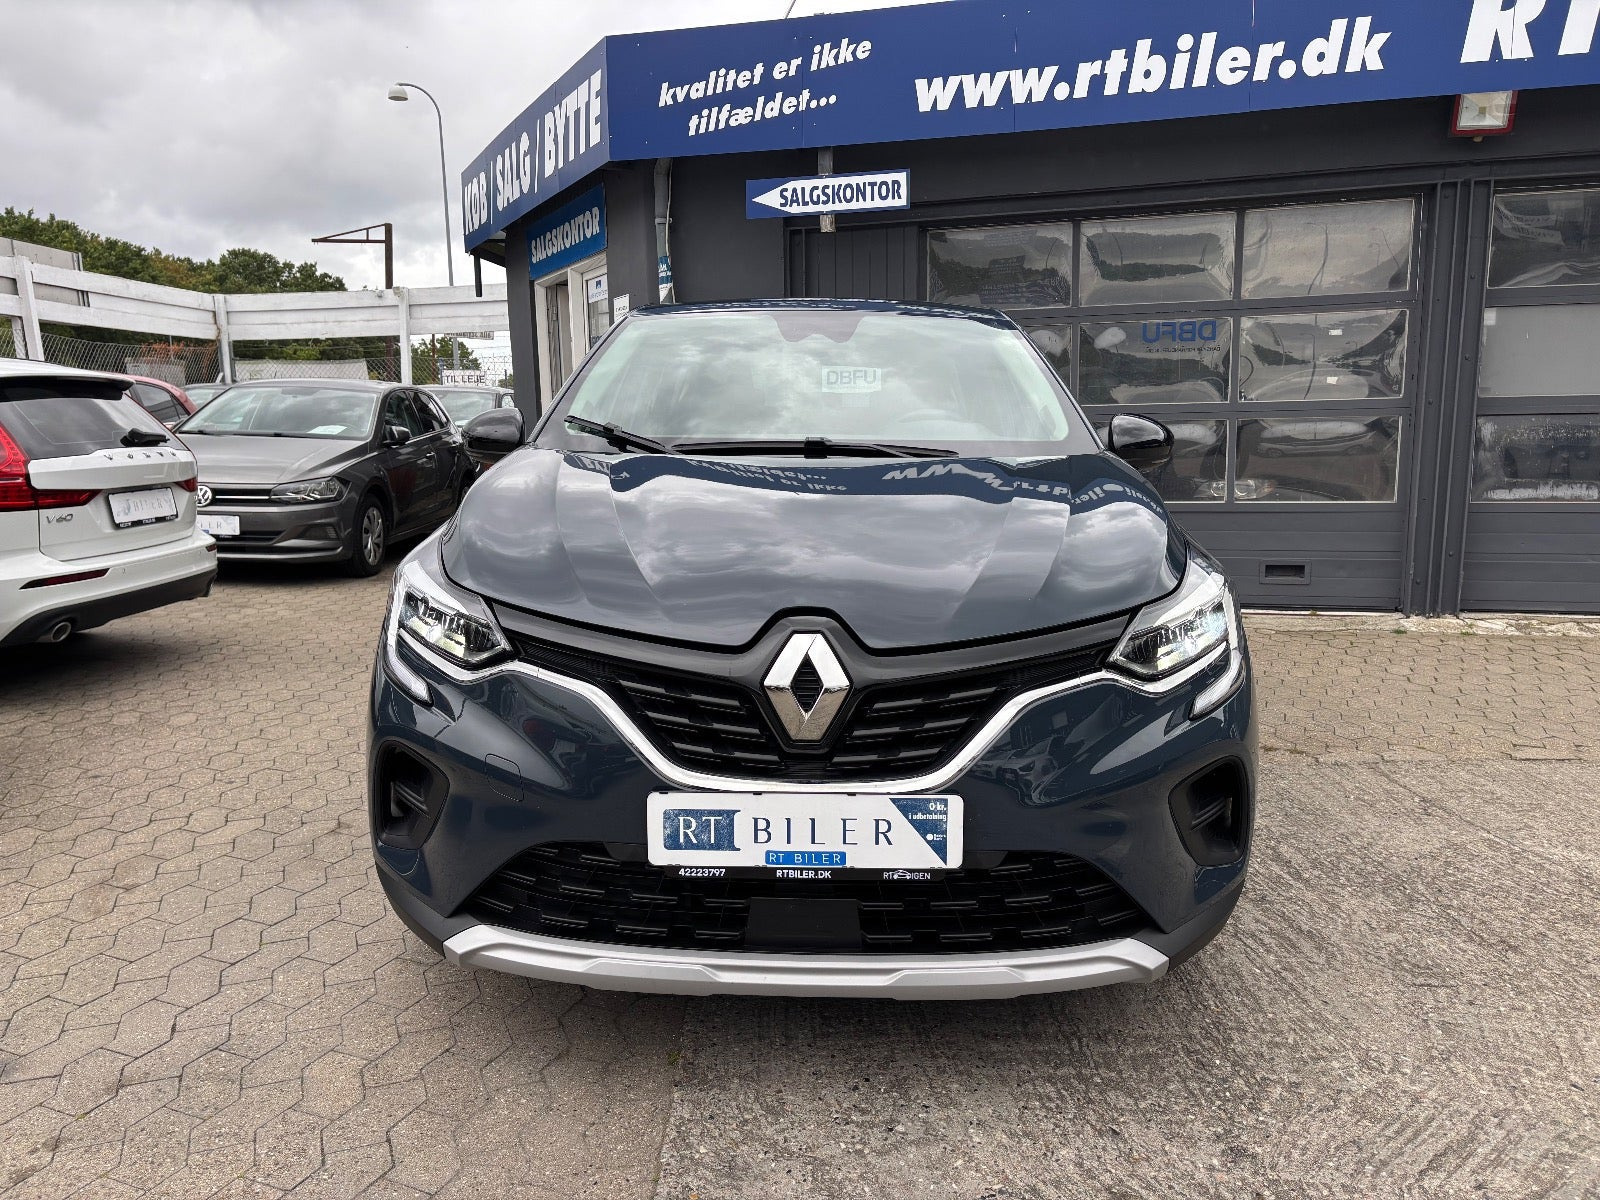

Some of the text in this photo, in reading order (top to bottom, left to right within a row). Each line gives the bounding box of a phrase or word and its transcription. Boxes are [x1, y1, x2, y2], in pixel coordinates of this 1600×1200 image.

[658, 38, 872, 107] kvalitet er ikke
[914, 15, 1393, 112] www.rtbiler.dk
[688, 89, 837, 136] tilfældet...
[464, 171, 488, 236] KØB
[495, 131, 531, 212] SALG
[544, 68, 602, 179] BYTTE
[779, 173, 903, 208] SALGSKONTOR
[531, 206, 600, 264] SALGSKONTOR
[826, 369, 877, 385] DBFU
[45, 513, 74, 524] V60
[678, 816, 894, 845] RT BILER
[679, 868, 726, 877] 42223797
[769, 853, 841, 864] RT BILER
[776, 869, 832, 879] RTBILER.DK
